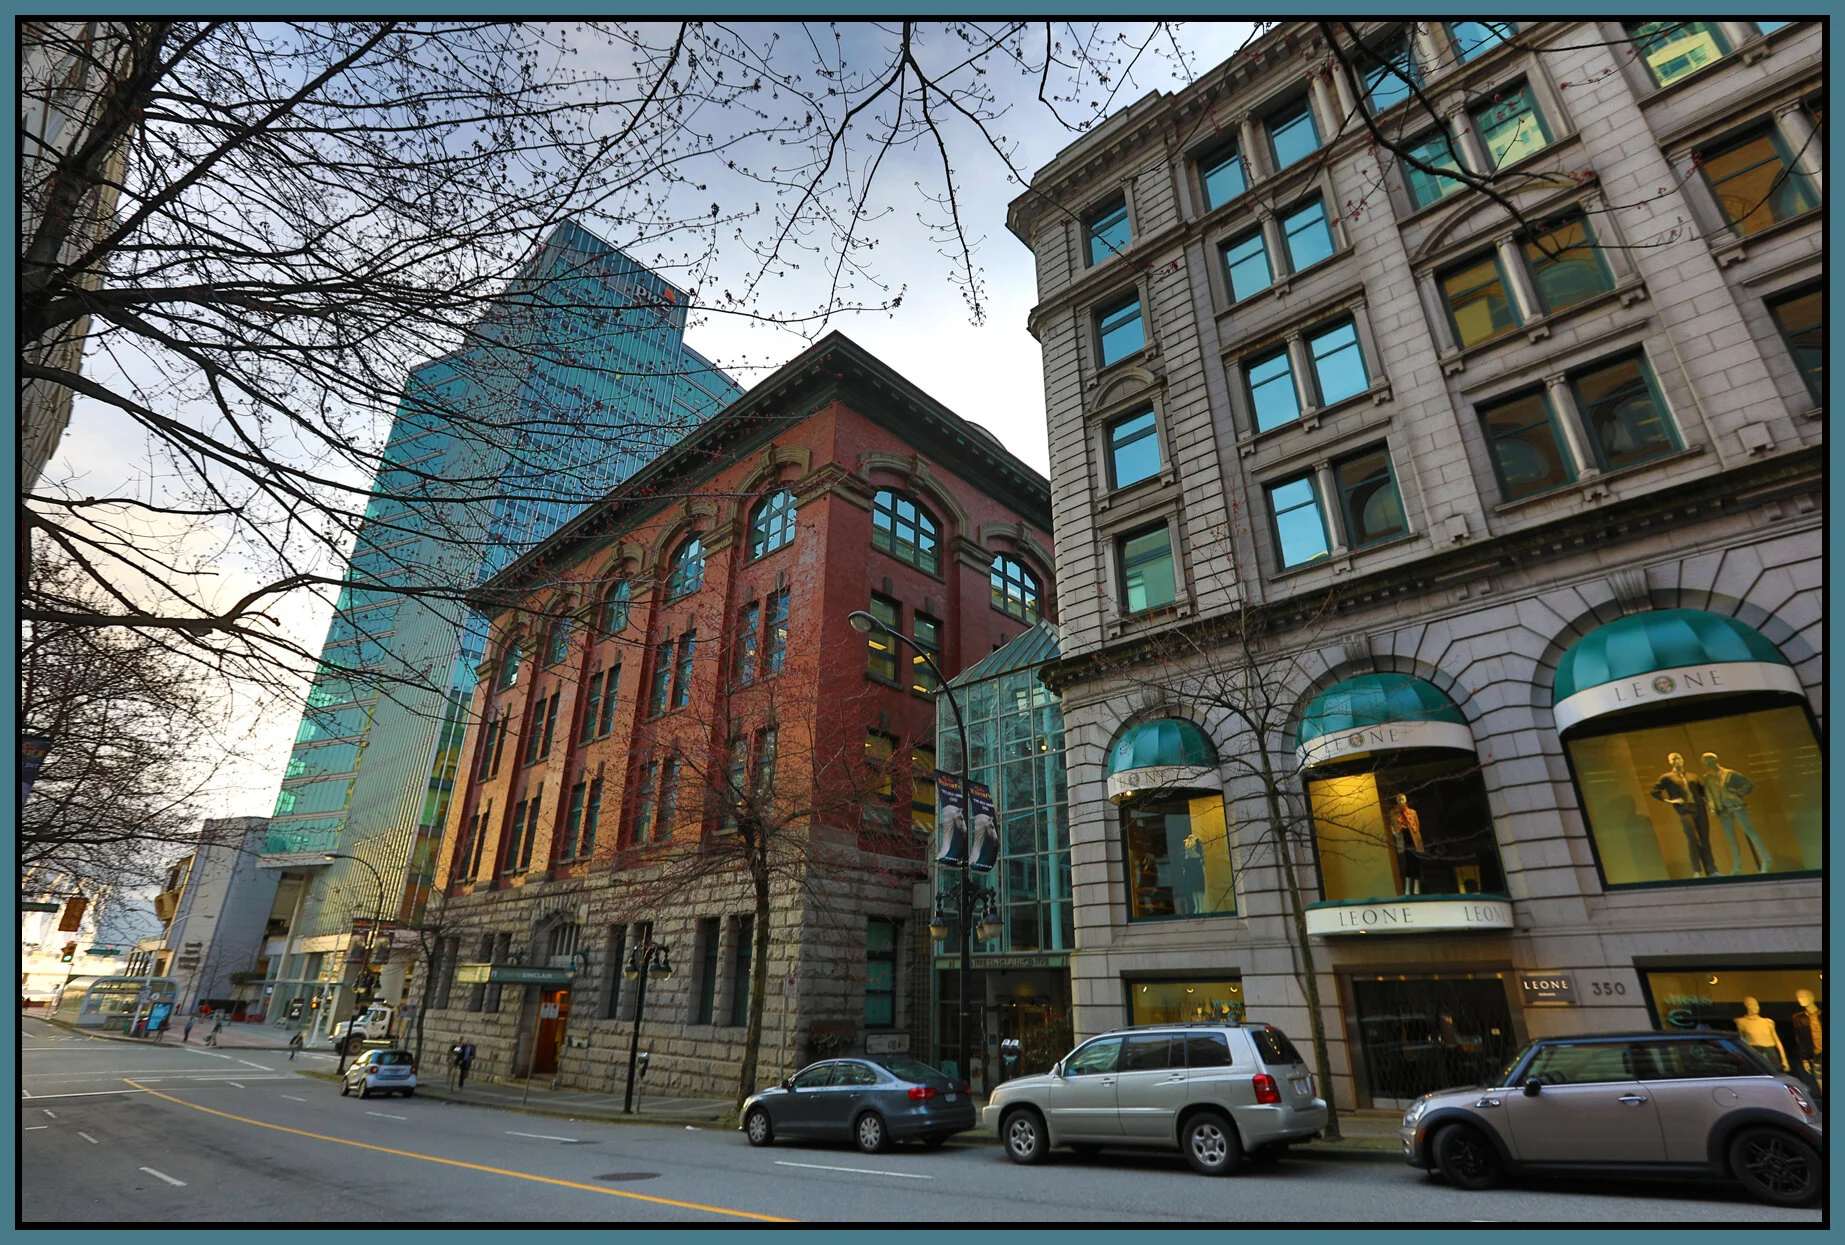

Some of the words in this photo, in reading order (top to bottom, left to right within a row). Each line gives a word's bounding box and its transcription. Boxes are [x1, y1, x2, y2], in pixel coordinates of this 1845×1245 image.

[1339, 907, 1414, 927] LEONE
[1523, 980, 1568, 990] LEONE
[1591, 982, 1626, 996] 350
